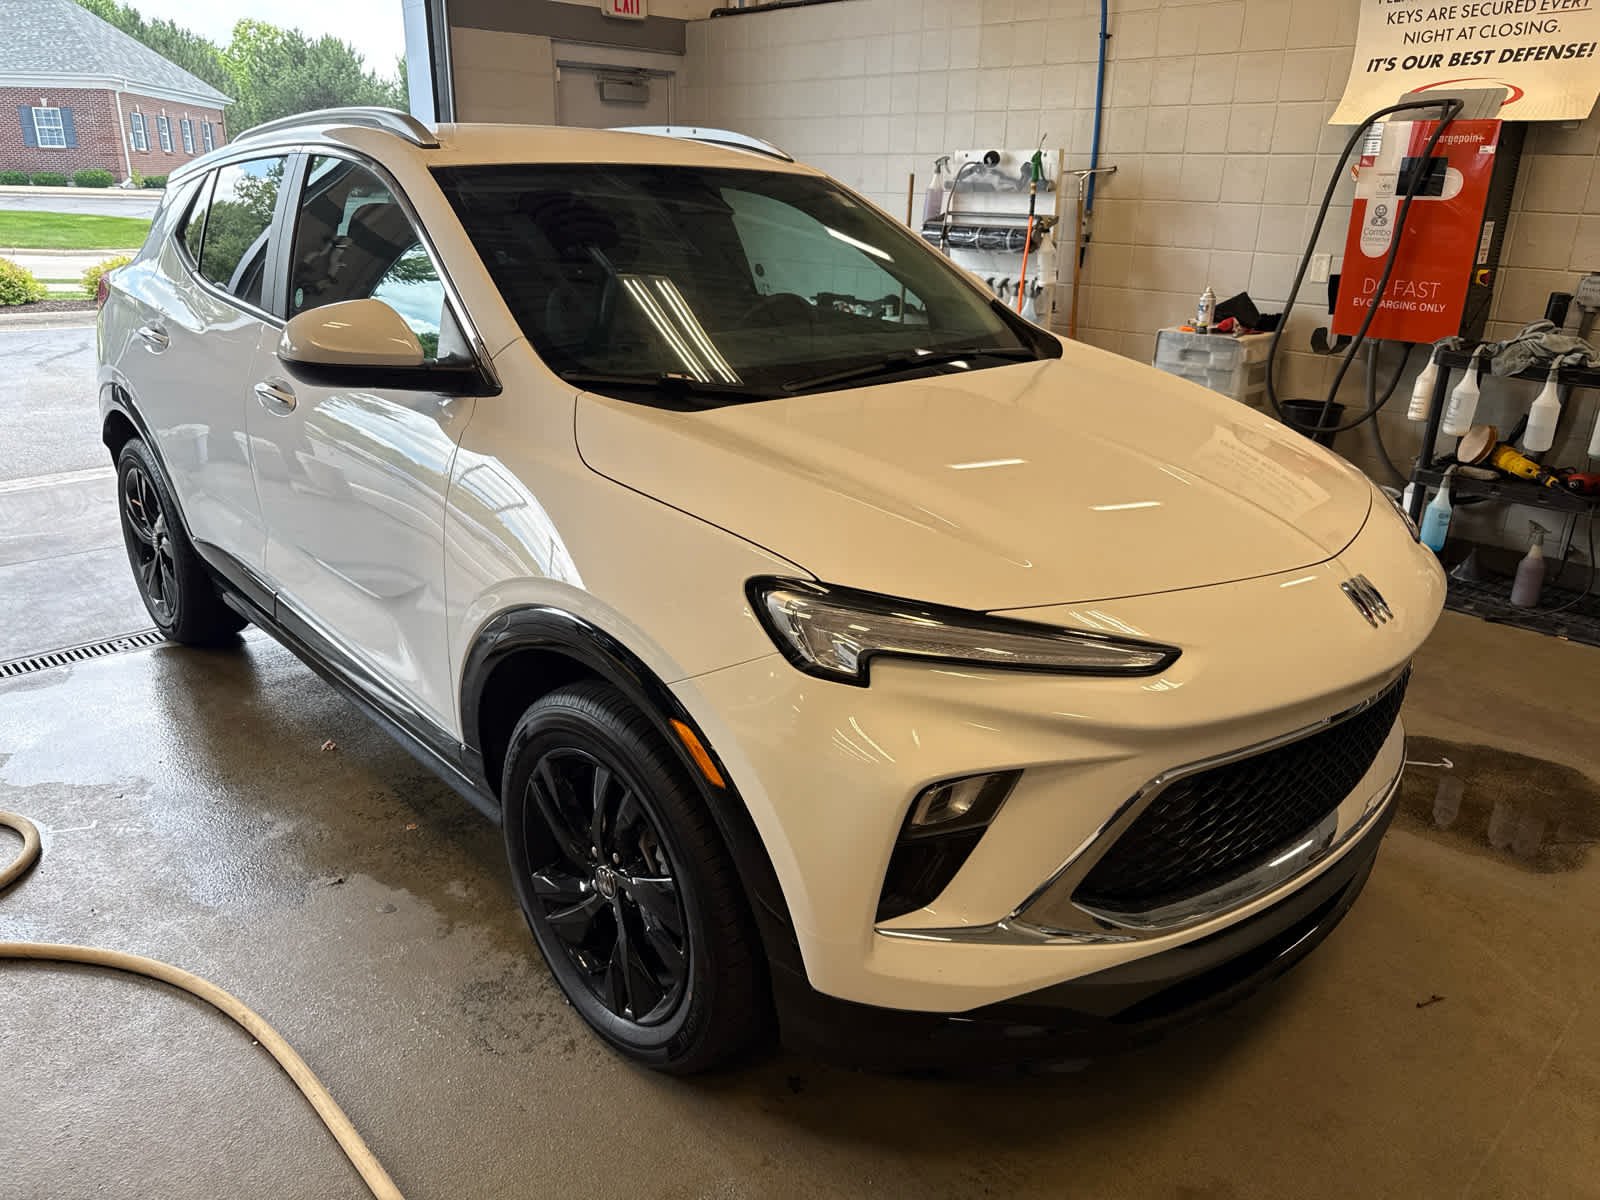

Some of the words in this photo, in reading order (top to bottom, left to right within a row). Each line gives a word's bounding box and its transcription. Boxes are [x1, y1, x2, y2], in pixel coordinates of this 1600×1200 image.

[1387, 9, 1423, 25] KEYS
[1426, 6, 1457, 22] ARE
[1461, 0, 1537, 19] SECURED
[1403, 28, 1454, 45] NIGHT
[1456, 26, 1477, 41] AT
[1479, 19, 1561, 39] CLOSING.
[1366, 57, 1398, 73] IT'S
[1402, 54, 1444, 70] OUR
[1448, 50, 1496, 67] BEST
[1498, 42, 1598, 64] DEFENSE!
[1393, 280, 1441, 299] FAST
[1353, 297, 1367, 307] EV
[1366, 298, 1417, 312] CARGING
[1419, 302, 1446, 313] ONLY
